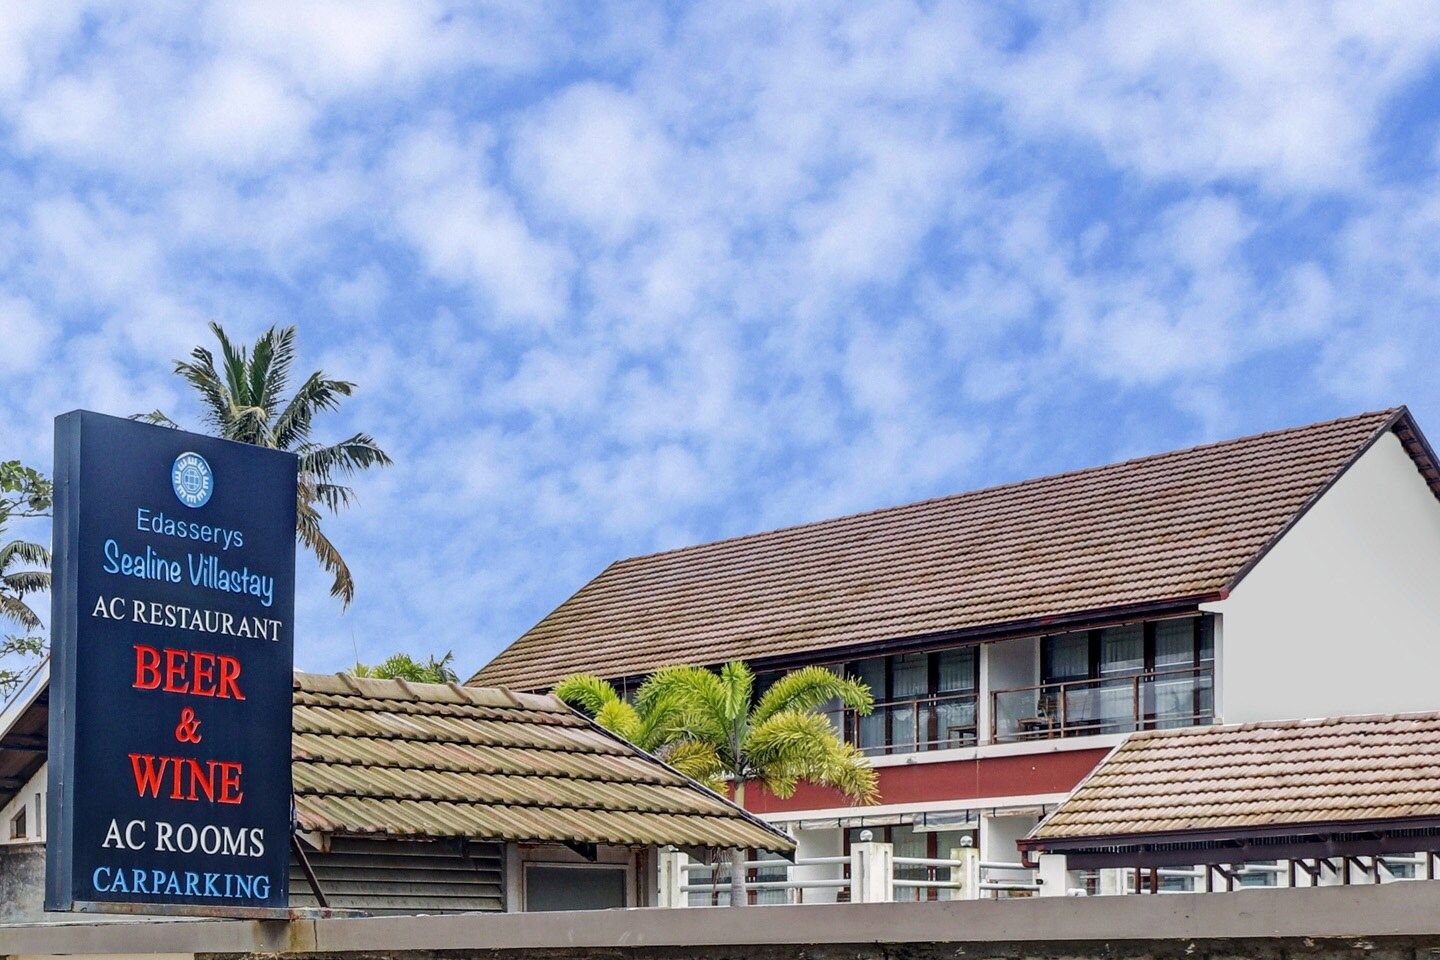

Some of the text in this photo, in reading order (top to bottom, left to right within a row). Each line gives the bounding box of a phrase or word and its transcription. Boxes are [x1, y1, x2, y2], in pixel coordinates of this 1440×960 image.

[137, 508, 244, 550] Edasserys
[103, 539, 274, 606] Sealine Villastay
[92, 595, 282, 642] AC RESTAURANT
[132, 645, 246, 701] BEER
[175, 706, 202, 744] &
[128, 753, 244, 804] WINE
[102, 818, 265, 857] AC ROOMS
[92, 866, 272, 899] CARPARKING
